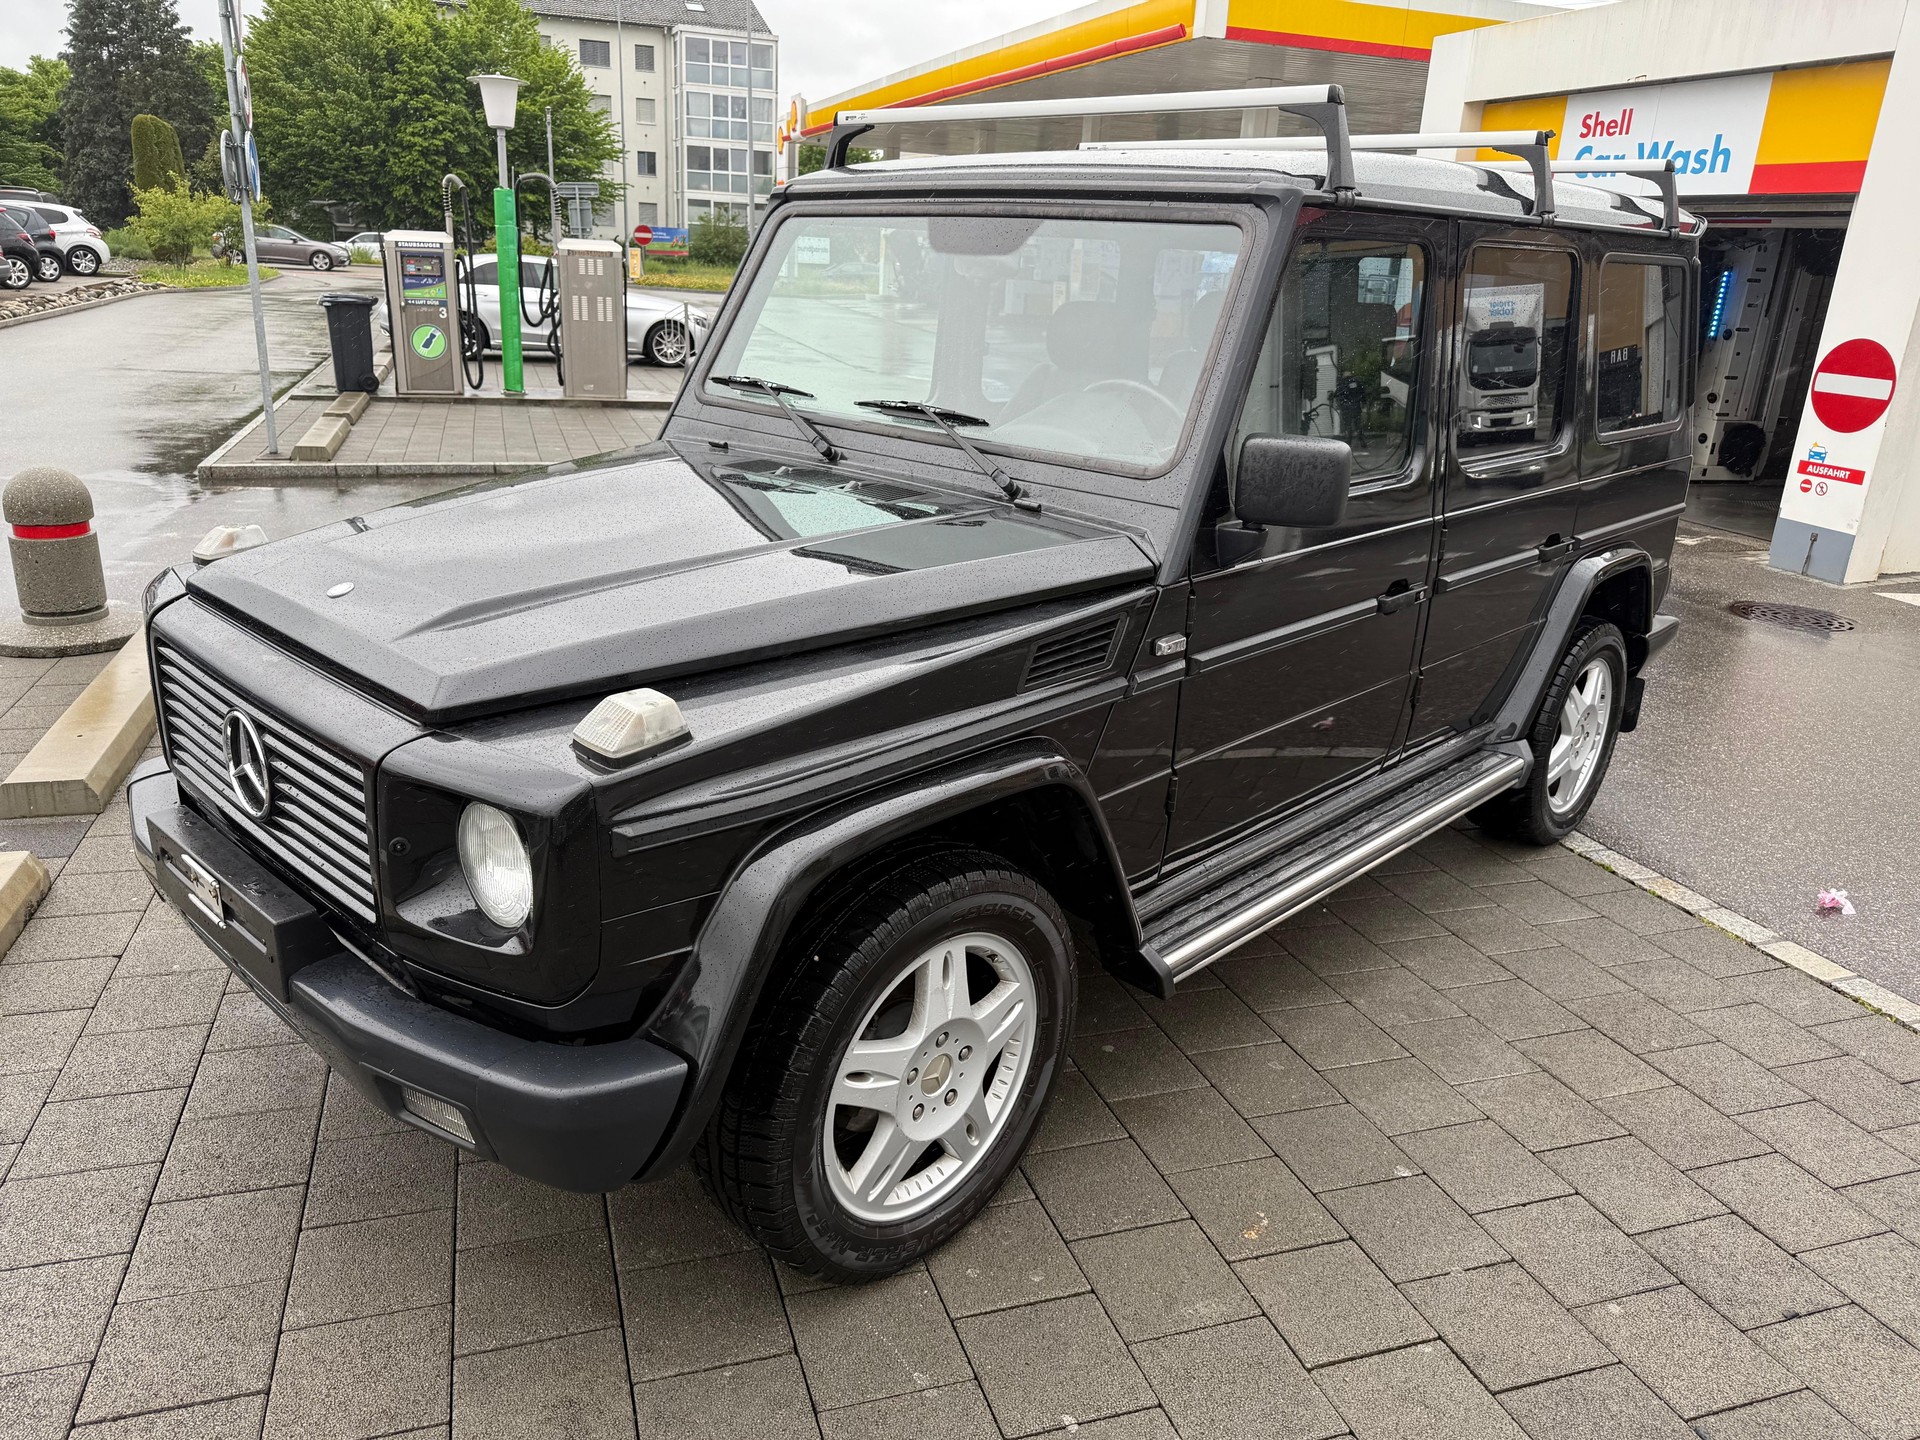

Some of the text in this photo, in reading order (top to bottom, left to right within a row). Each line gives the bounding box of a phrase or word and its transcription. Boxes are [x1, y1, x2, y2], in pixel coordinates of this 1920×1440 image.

[1579, 108, 1634, 139] Shell
[439, 307, 447, 318] 3
[1807, 465, 1850, 479] AUSFAHRT
